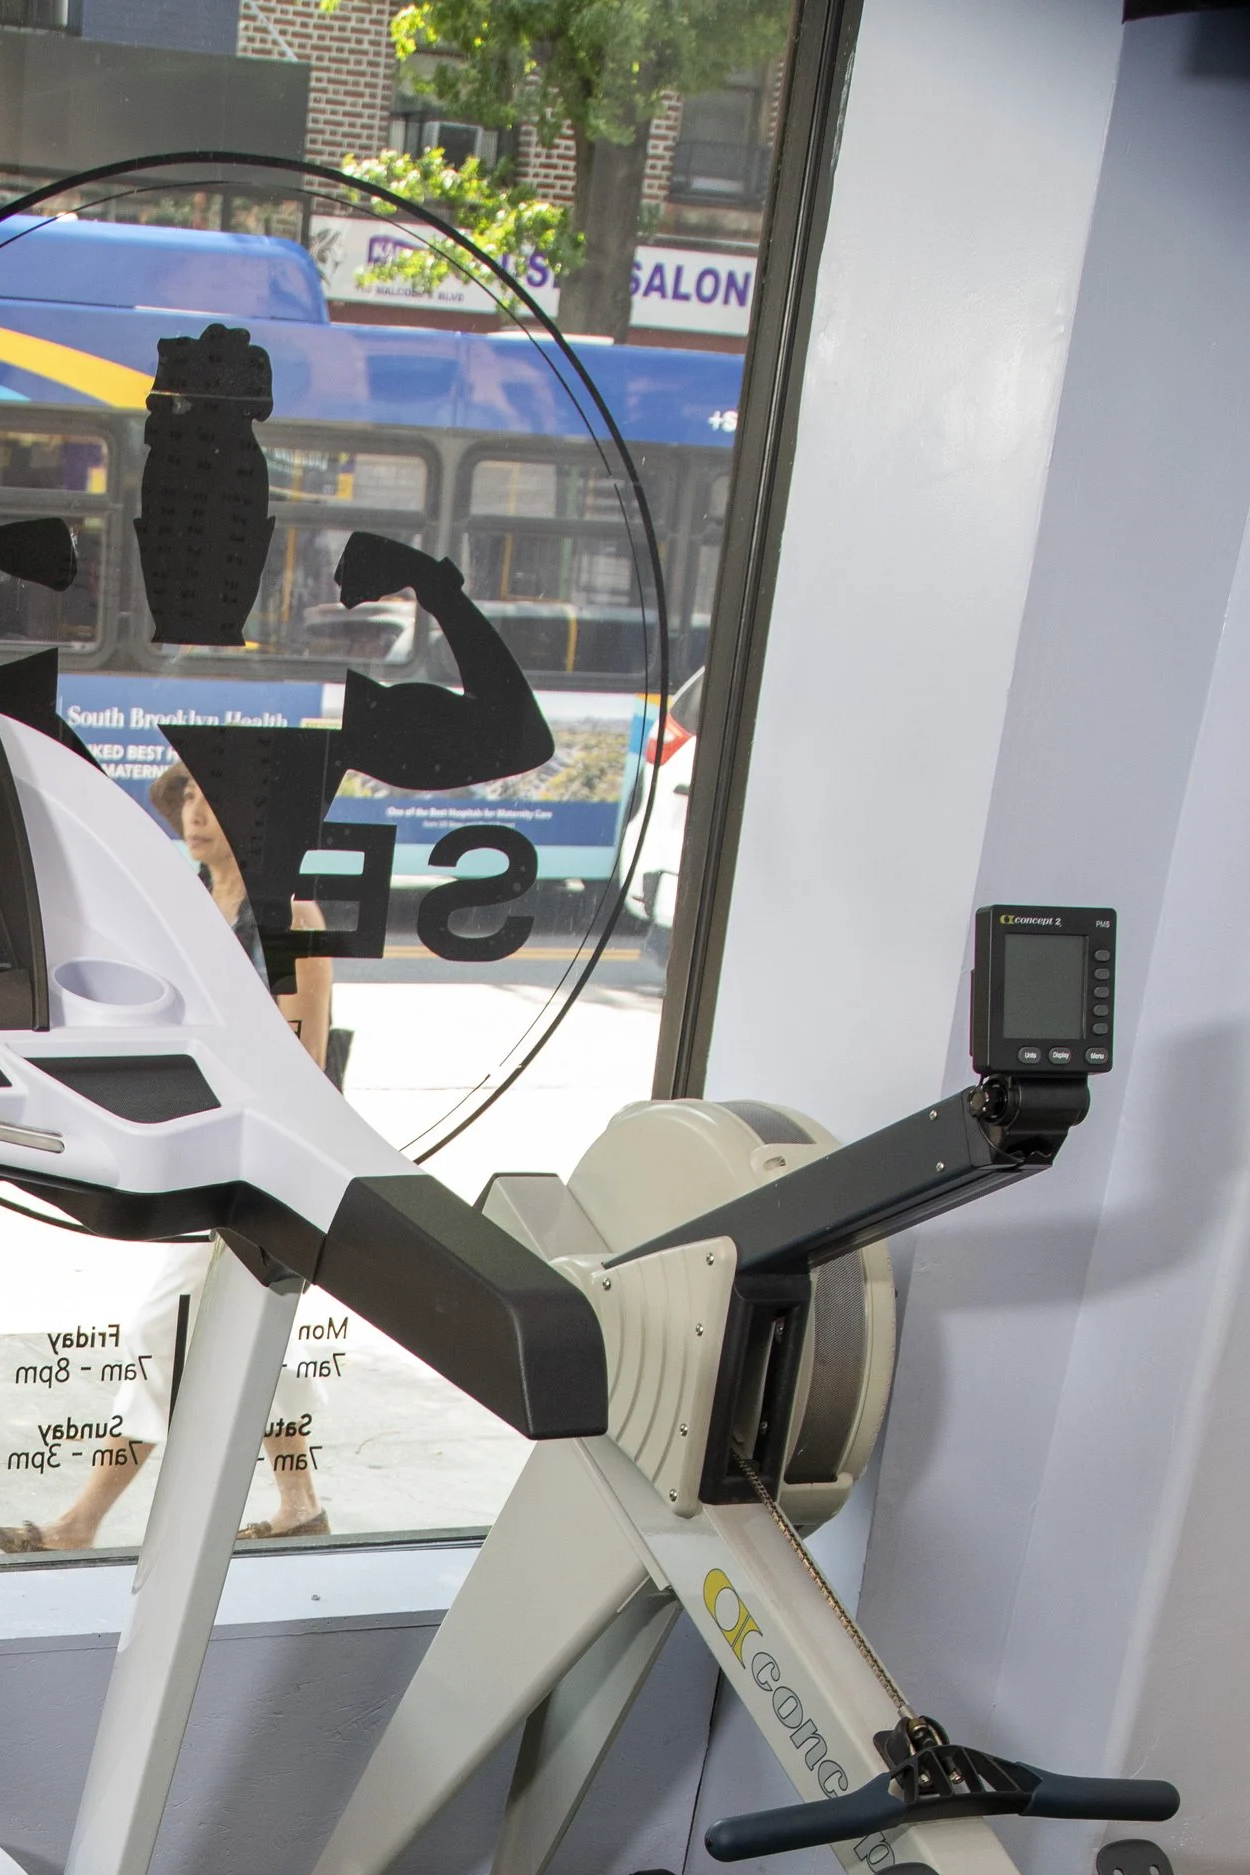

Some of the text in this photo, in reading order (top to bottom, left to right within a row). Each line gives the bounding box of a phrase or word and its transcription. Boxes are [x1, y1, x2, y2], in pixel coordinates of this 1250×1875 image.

[630, 261, 752, 307] SALON
[67, 705, 125, 728] South
[130, 707, 219, 730] Brooklyn
[225, 711, 288, 728] Health
[127, 745, 165, 762] BEST
[1014, 916, 1062, 926] concept 2
[1095, 920, 1110, 929] PM5
[1052, 1051, 1070, 1060] Display
[751, 1652, 896, 1874] concp
